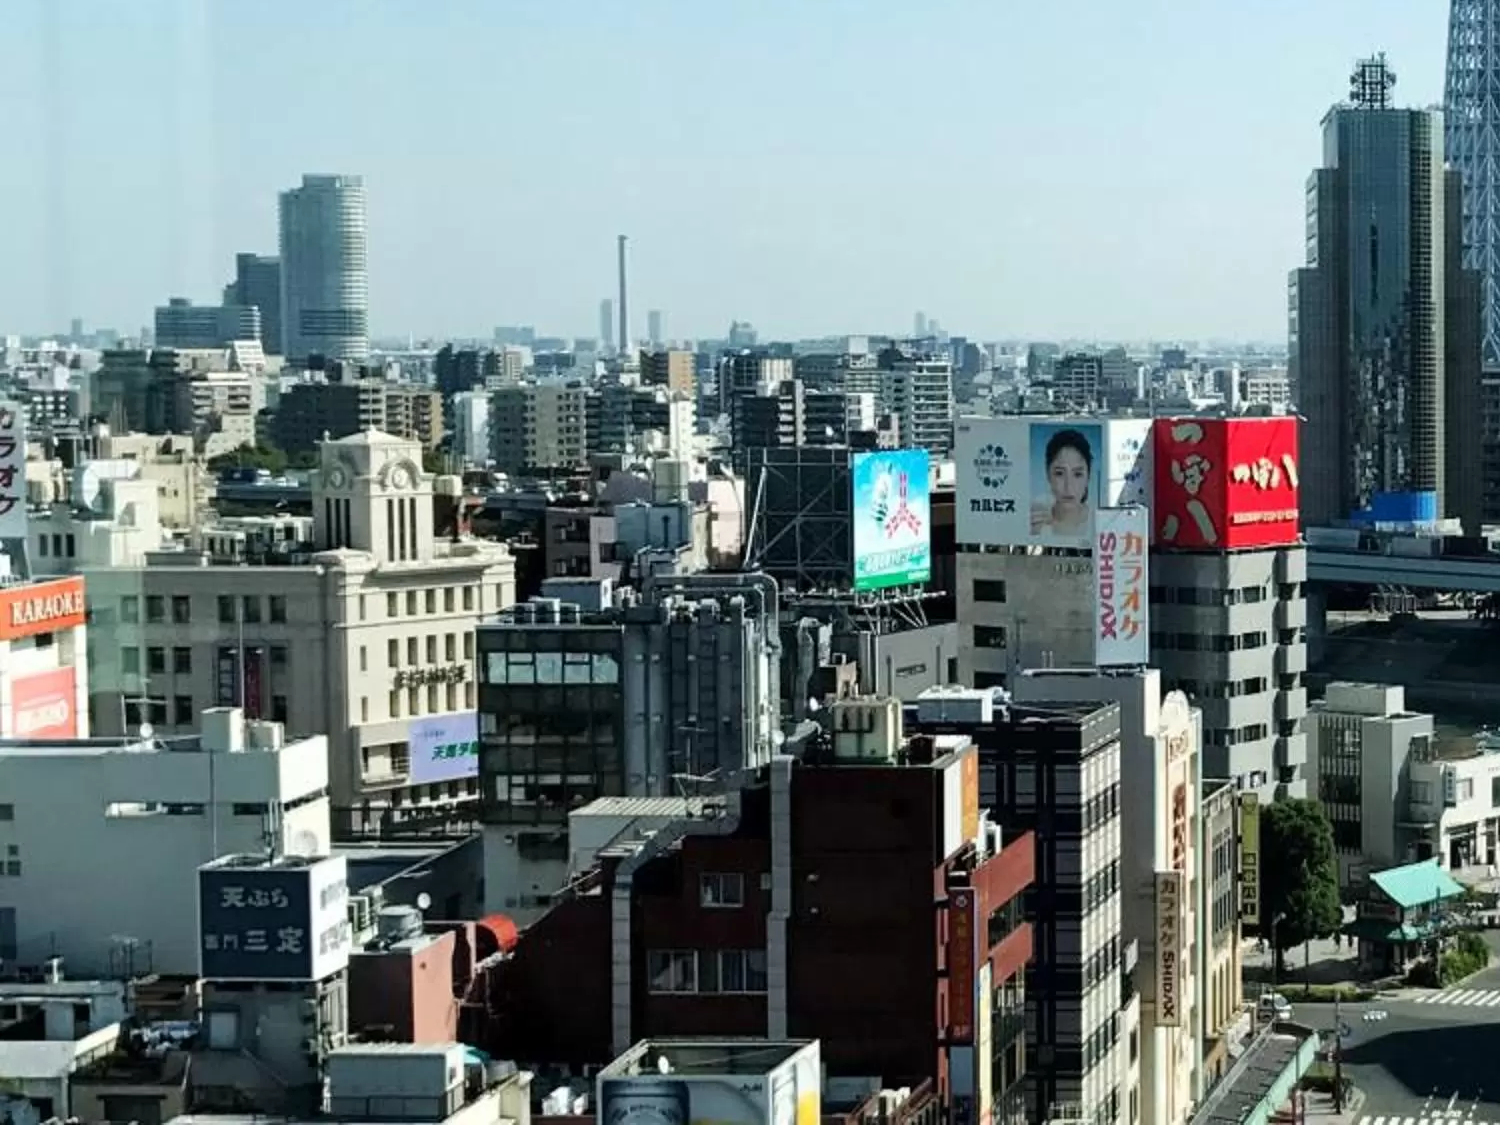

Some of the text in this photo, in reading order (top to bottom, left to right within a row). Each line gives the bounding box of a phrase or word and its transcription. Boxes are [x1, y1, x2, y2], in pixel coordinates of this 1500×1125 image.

[969, 498, 1016, 513] カルピス
[1162, 422, 1218, 545] つぼ八
[1232, 452, 1299, 492] つぼ八
[12, 589, 84, 625] KARAOKE
[1099, 531, 1117, 641] SHIDAX
[1119, 530, 1143, 641] カラオケ
[1162, 951, 1176, 1019] SHIDAX
